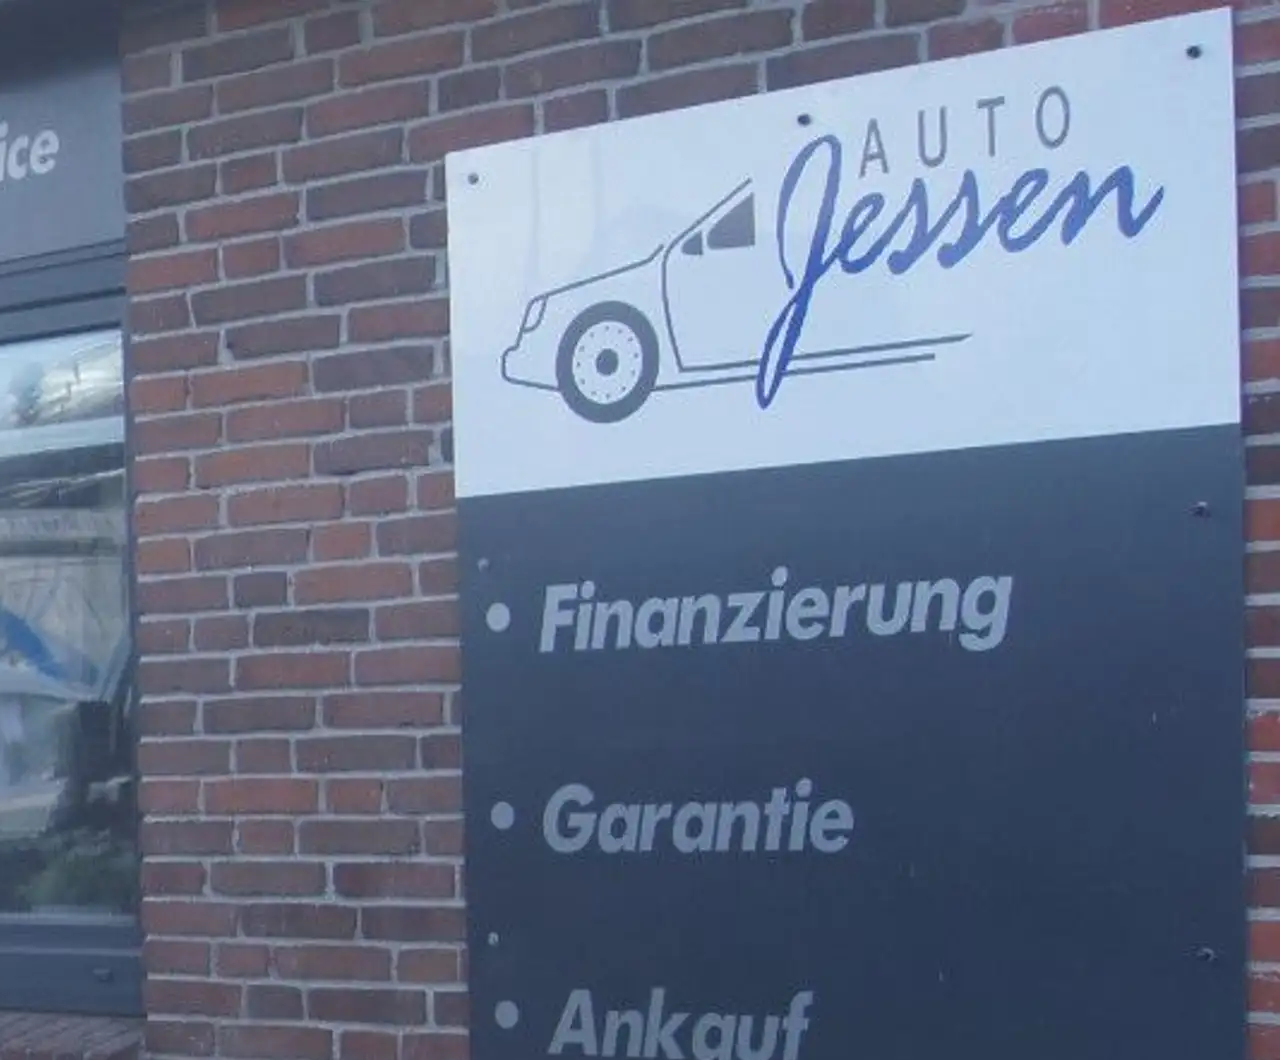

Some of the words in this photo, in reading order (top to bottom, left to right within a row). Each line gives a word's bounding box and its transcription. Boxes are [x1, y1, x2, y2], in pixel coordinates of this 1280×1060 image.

[858, 85, 1071, 179] AUTO
[756, 134, 1164, 410] Jessen
[539, 566, 1012, 652] Finanzierung
[542, 777, 854, 853] Garantie
